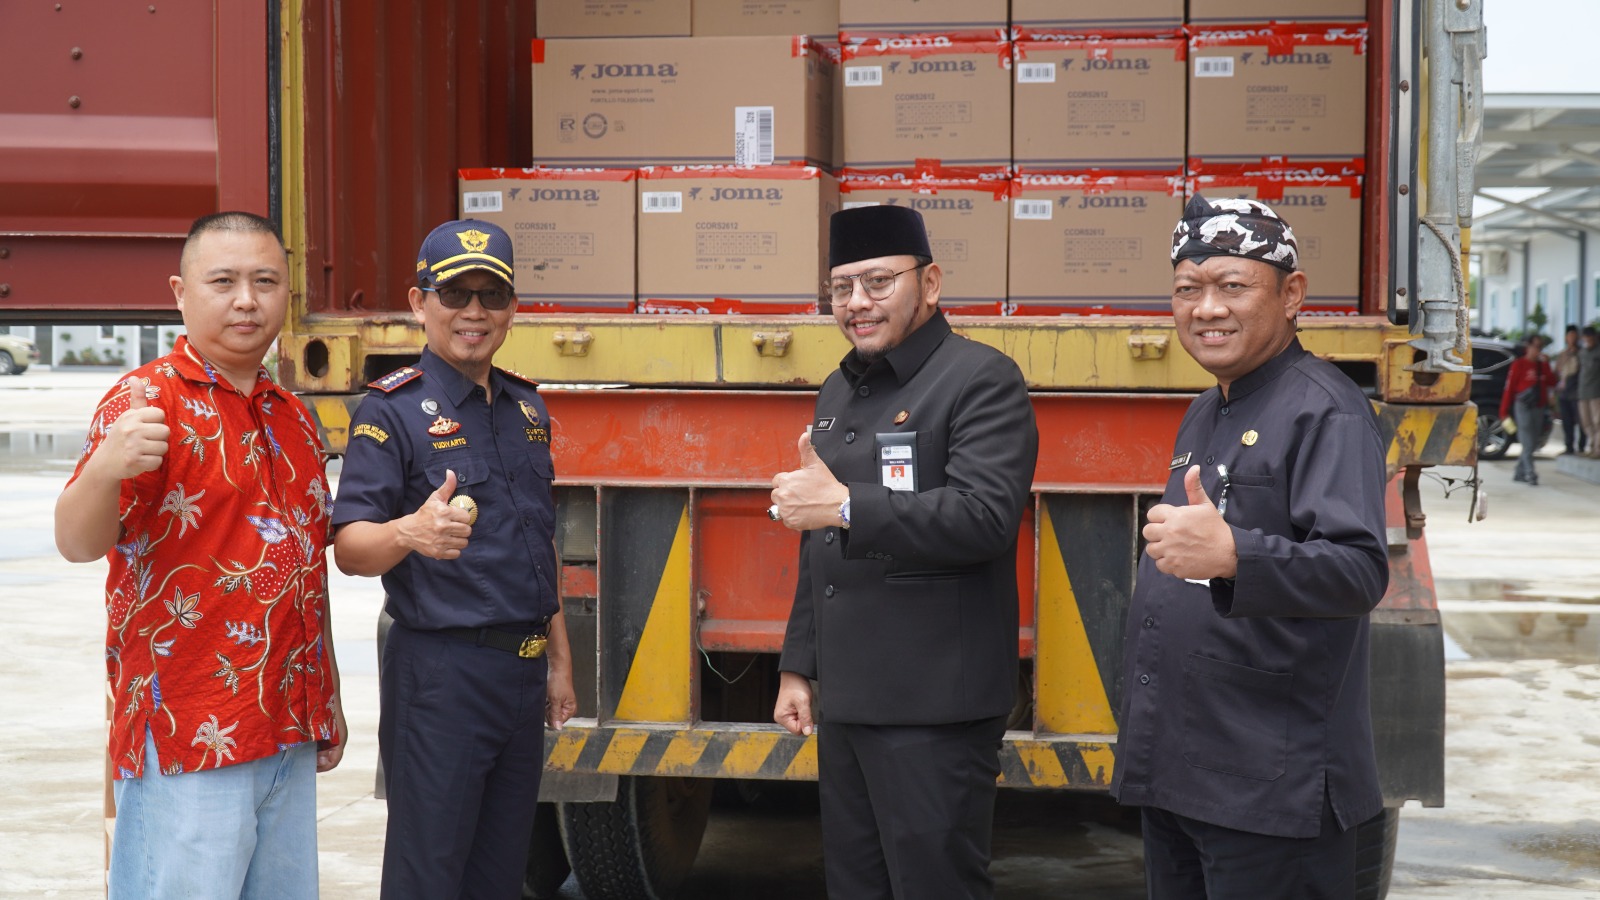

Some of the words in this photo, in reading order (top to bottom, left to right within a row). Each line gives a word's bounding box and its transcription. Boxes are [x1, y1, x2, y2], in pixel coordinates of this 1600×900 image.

[875, 36, 953, 51] Joma
[591, 63, 678, 79] Joma
[908, 59, 976, 74] Joma
[1081, 58, 1150, 71] Joma
[529, 188, 600, 202] Joma
[709, 187, 783, 201] Joma
[1078, 196, 1148, 209] Joma
[514, 222, 557, 230] CCORS2612
[695, 222, 739, 230] CCORS2612
